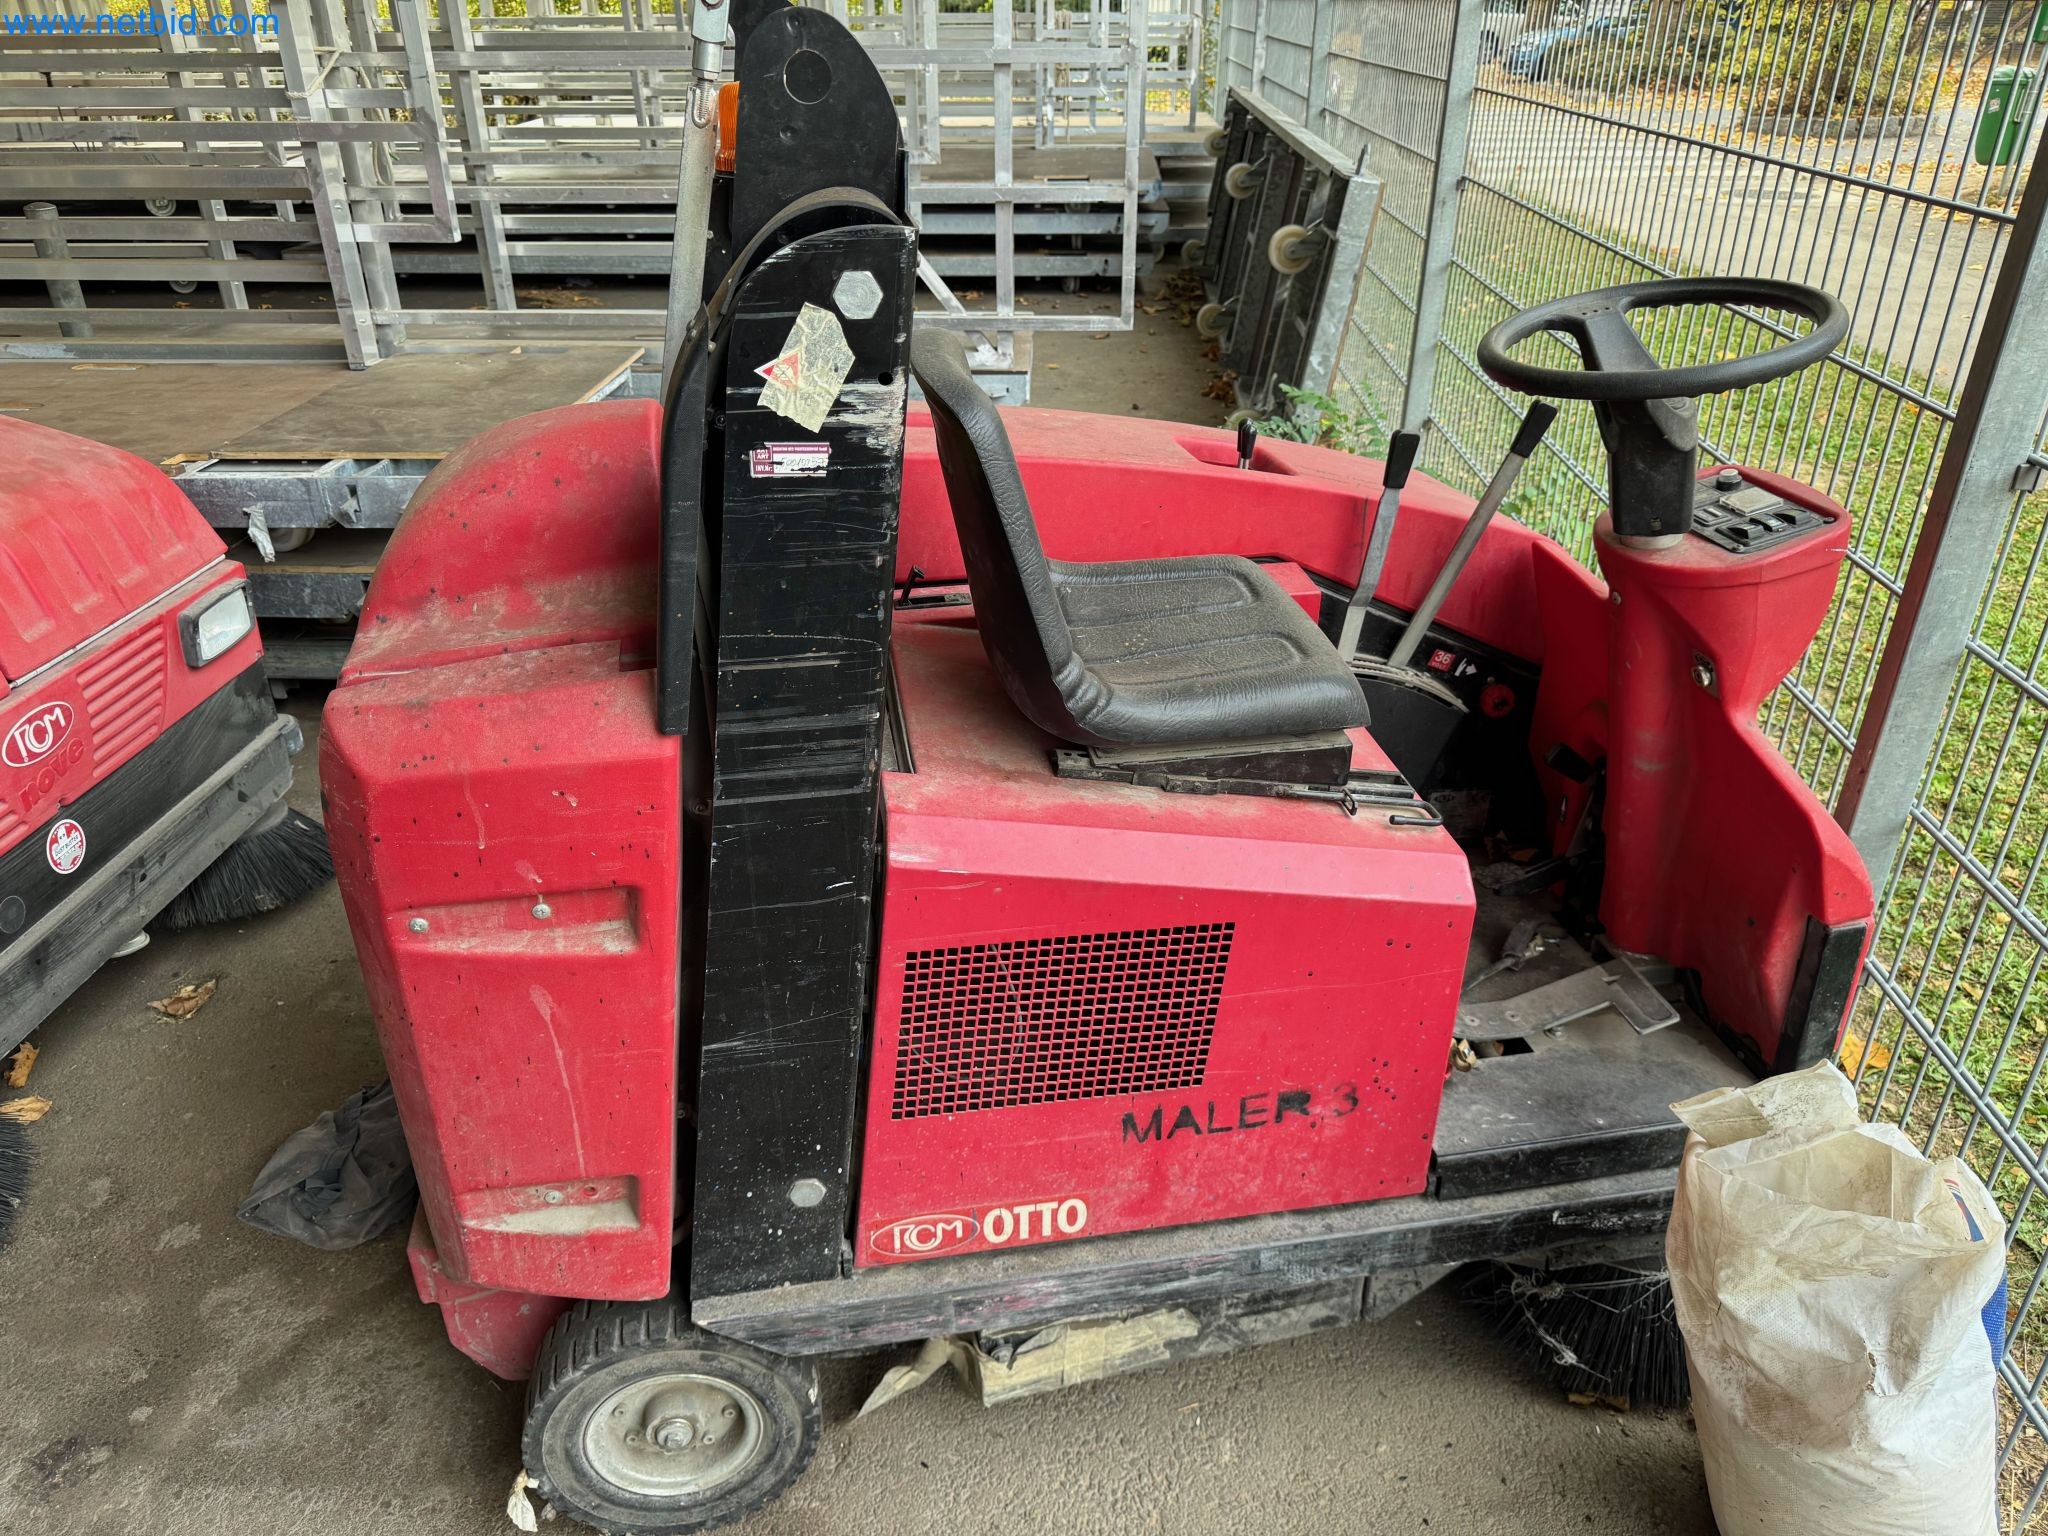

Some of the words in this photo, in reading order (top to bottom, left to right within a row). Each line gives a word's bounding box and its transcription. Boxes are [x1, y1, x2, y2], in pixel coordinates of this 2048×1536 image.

[1434, 651, 1451, 664] 36
[1122, 1090, 1312, 1143] MALER
[1333, 1081, 1359, 1117] 3
[983, 1198, 1089, 1244] OTTO
